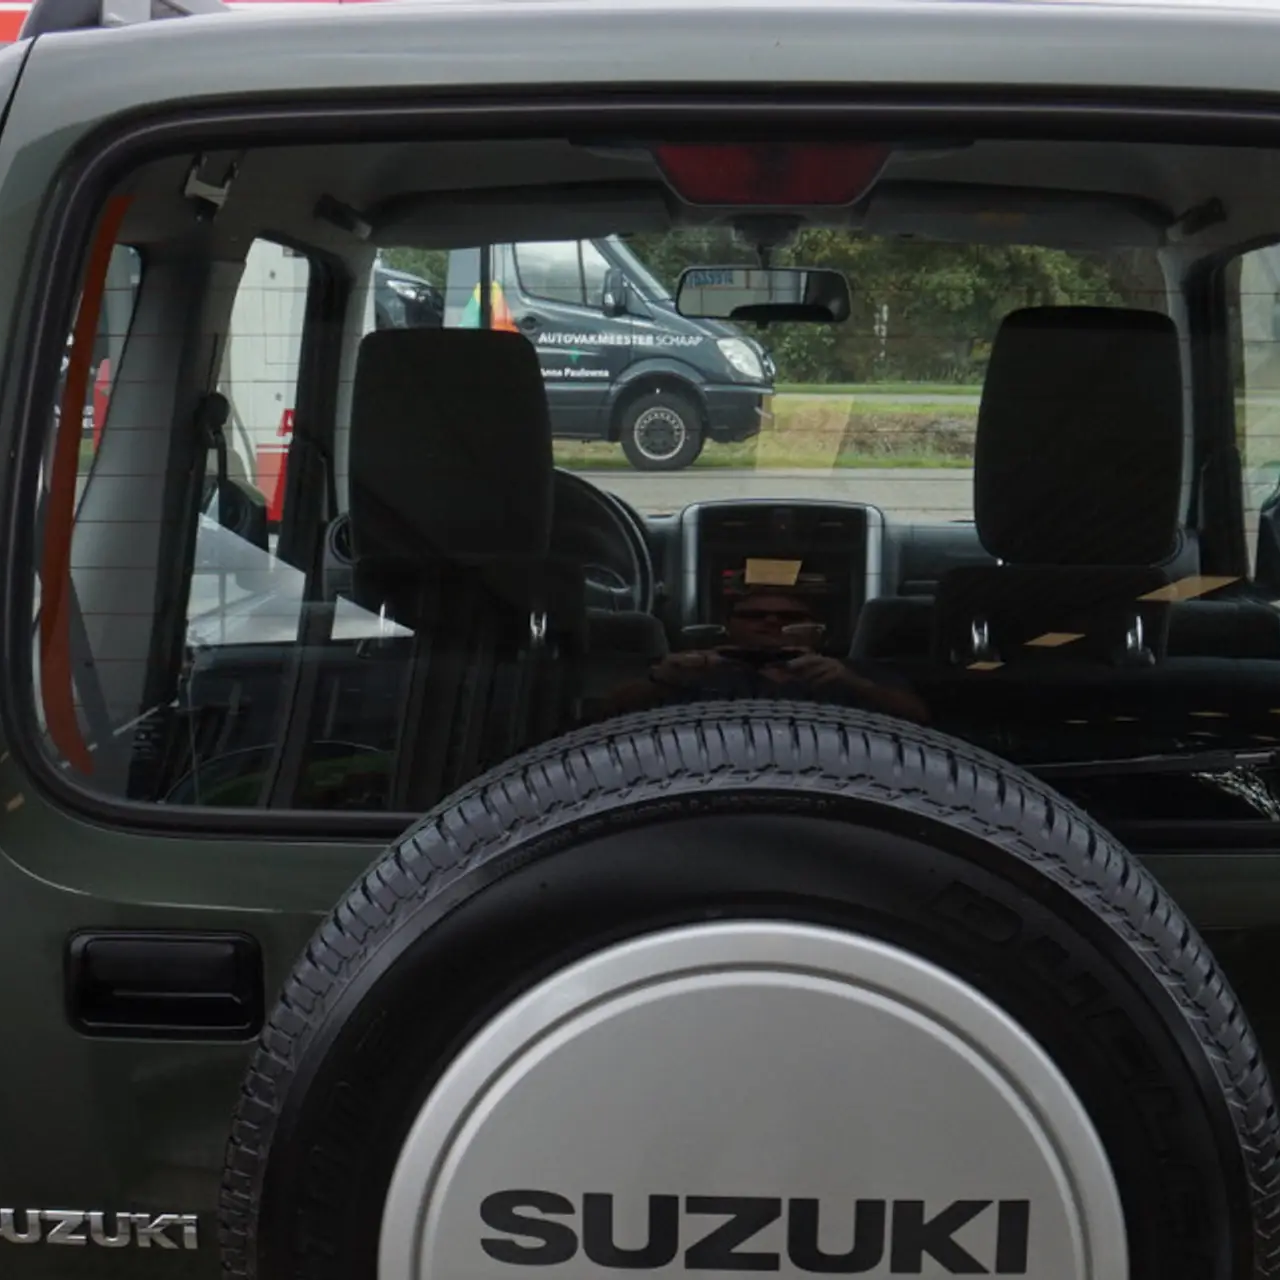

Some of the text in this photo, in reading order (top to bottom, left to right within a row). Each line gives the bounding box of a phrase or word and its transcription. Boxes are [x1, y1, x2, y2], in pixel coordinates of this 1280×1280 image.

[538, 332, 703, 346] AUTOVAKMEESTER SCHAAP
[479, 1188, 1031, 1274] SUZUKI
